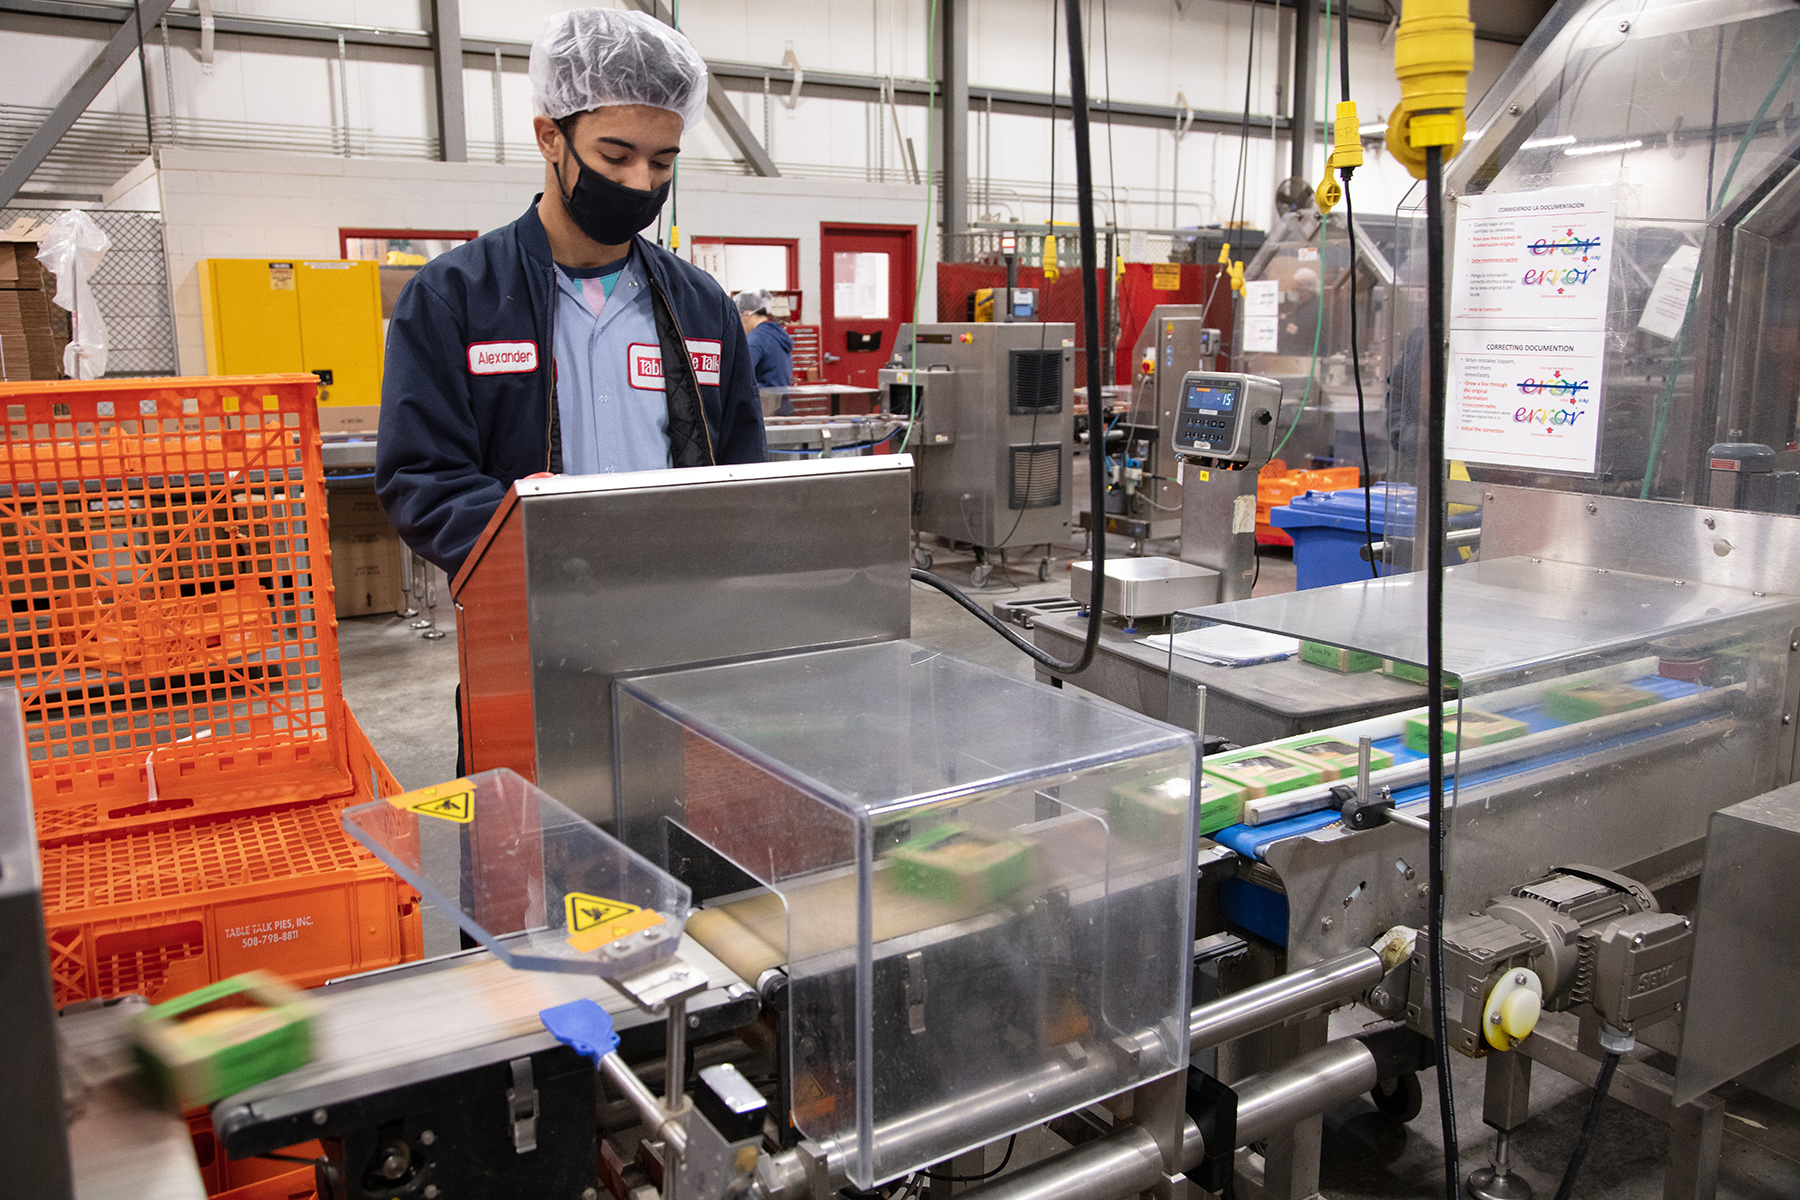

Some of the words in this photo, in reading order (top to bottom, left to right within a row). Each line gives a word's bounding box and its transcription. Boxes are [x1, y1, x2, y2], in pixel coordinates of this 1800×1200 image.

[1524, 268, 1597, 285] error
[478, 350, 533, 365] Alexander
[639, 359, 663, 375] Tabl
[1514, 406, 1584, 426] error
[1309, 646, 1322, 655] Apple
[224, 926, 250, 938] TABLE
[252, 922, 272, 934] TALK
[274, 919, 294, 930] PIES,
[296, 916, 313, 927] INC.
[242, 930, 299, 948] 508-798-8811
